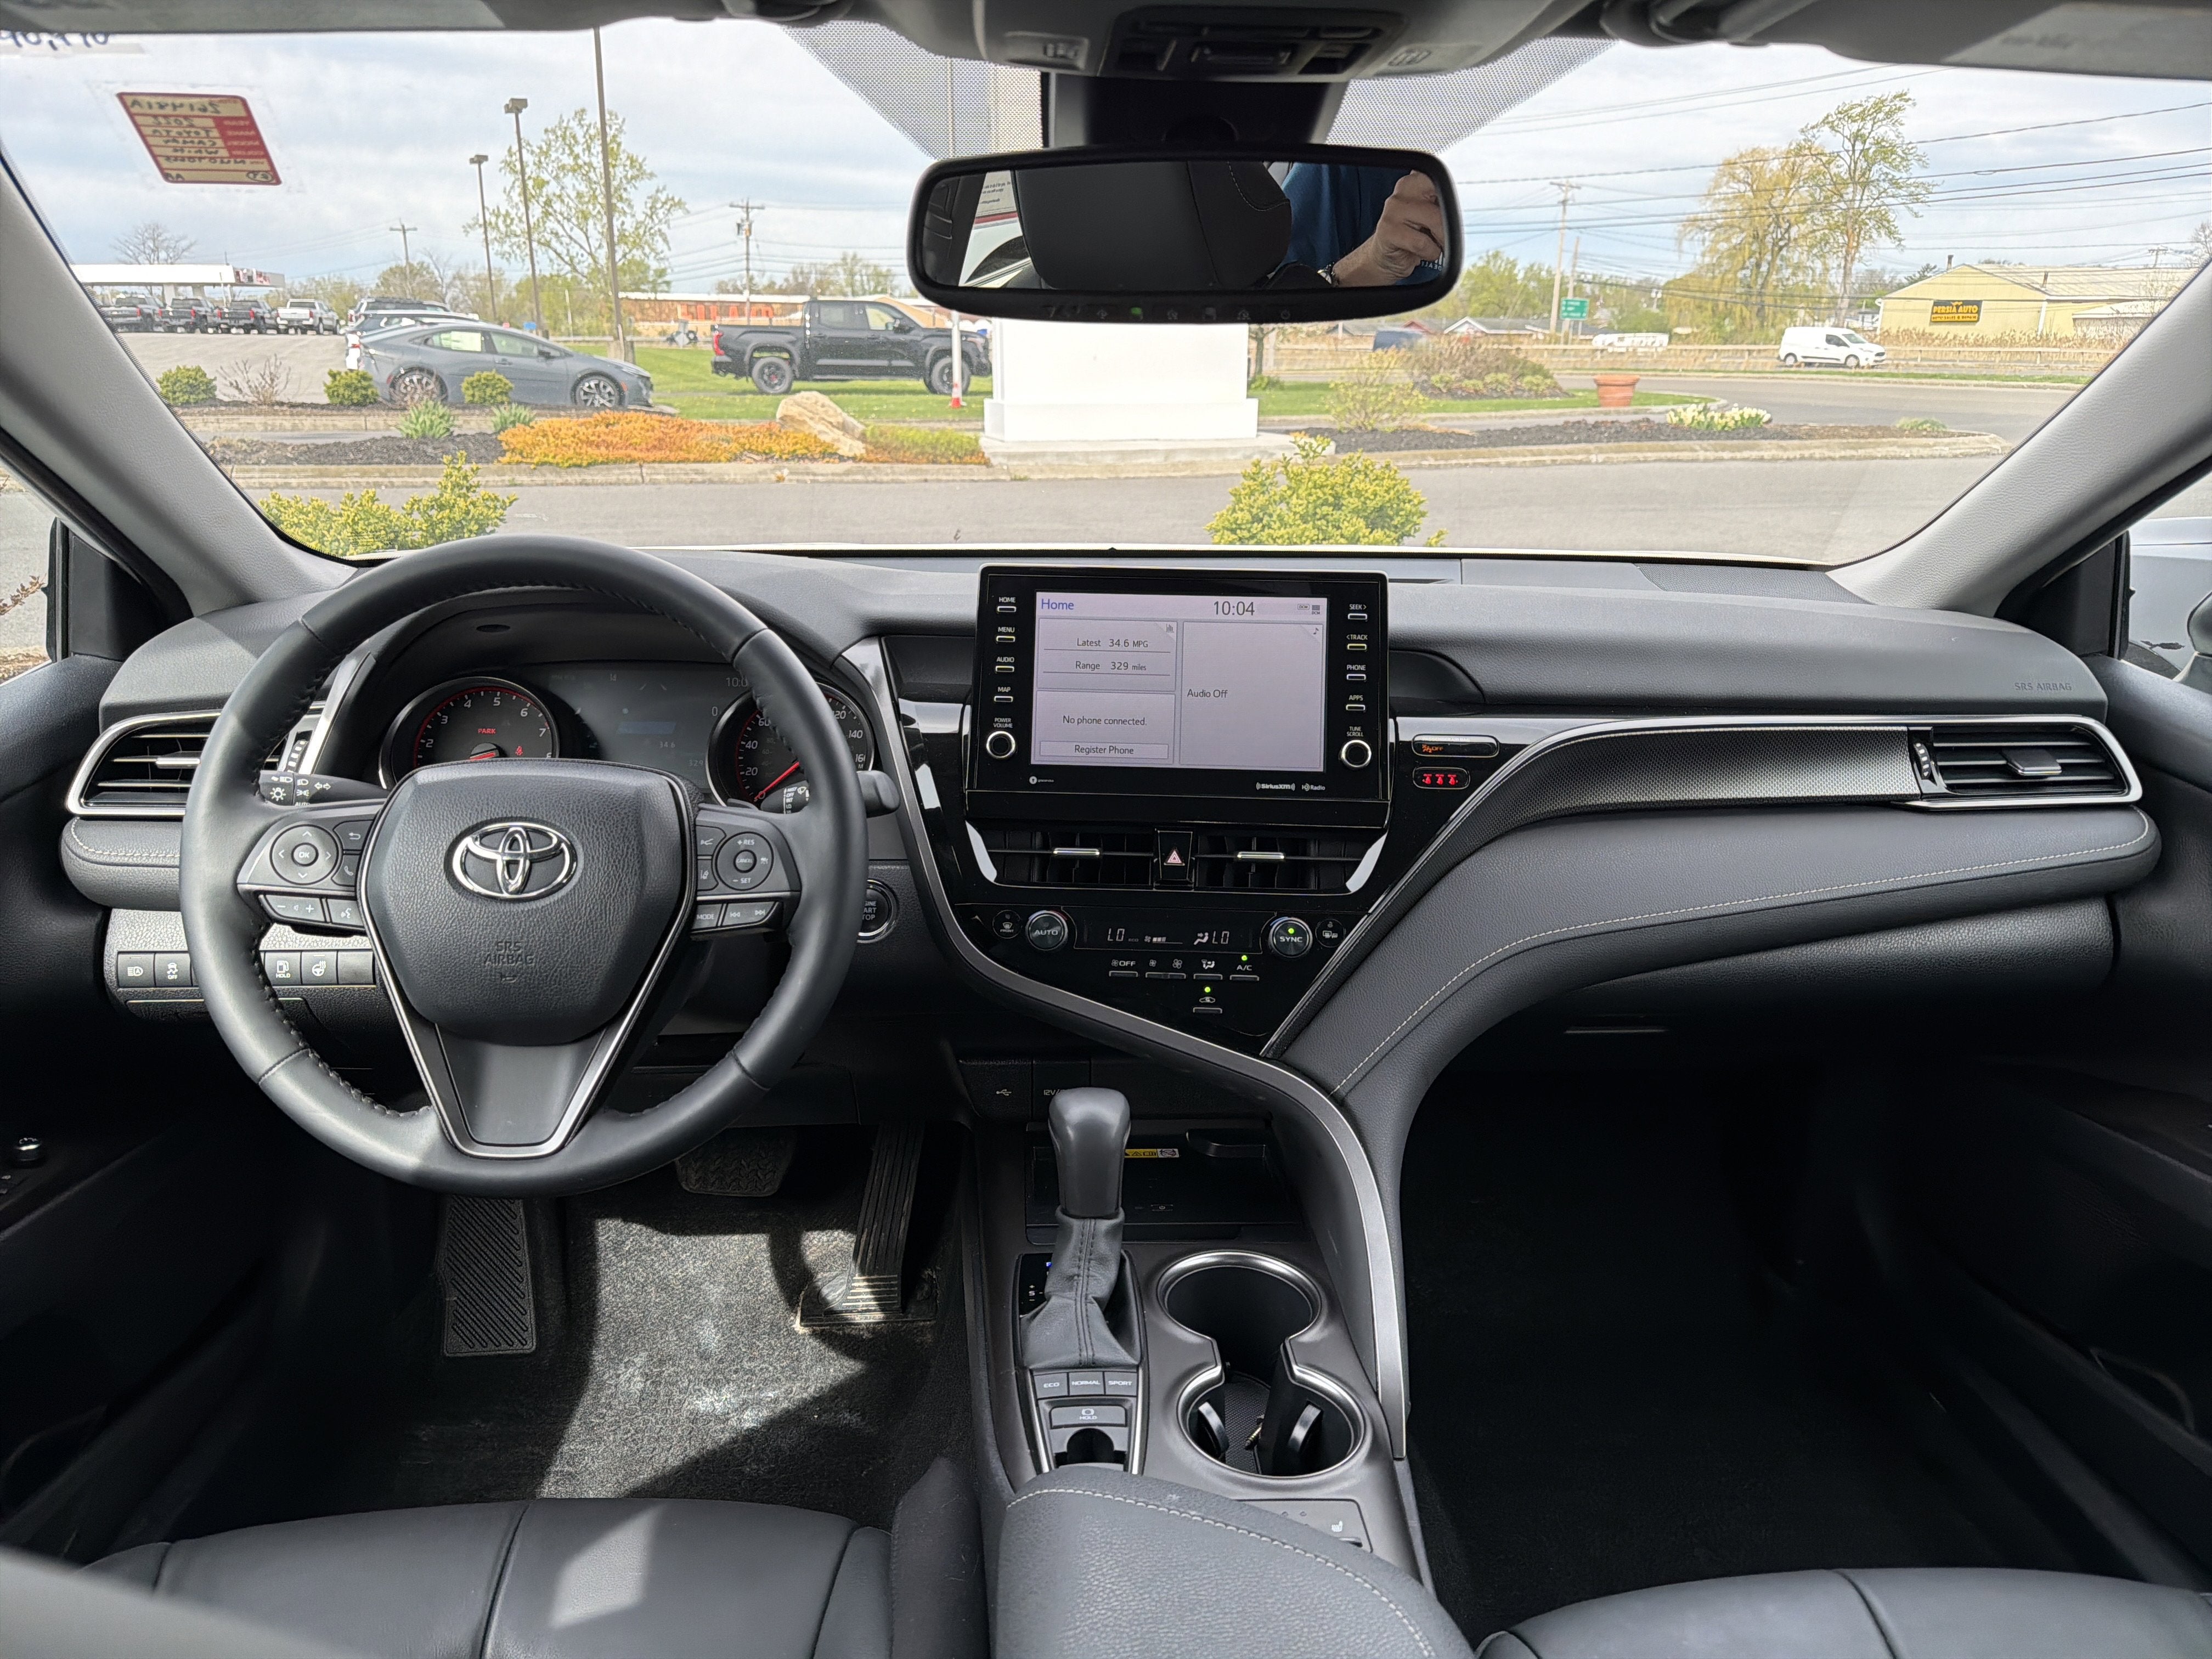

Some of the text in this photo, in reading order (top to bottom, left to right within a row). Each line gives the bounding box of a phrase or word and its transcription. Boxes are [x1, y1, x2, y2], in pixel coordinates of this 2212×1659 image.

[1041, 599, 1074, 610] Home
[1214, 601, 1255, 616] 10:04
[1077, 638, 1101, 647] Latest
[1109, 639, 1130, 647] 34.6
[1075, 661, 1101, 671] Range
[1110, 662, 1128, 670] 329
[726, 677, 747, 687] 10:0
[2015, 682, 2073, 691] SRS AIRBAG
[1187, 689, 1228, 698] Audio Off
[464, 698, 471, 708] 4
[493, 697, 501, 706] 5
[520, 708, 528, 717] 6
[441, 715, 448, 725] 3
[1063, 715, 1147, 726] No phone connected.
[539, 728, 547, 737] 7
[848, 730, 863, 739] 140
[425, 738, 433, 748] 2
[746, 740, 758, 749] 40
[1074, 744, 1134, 755] Register Phone
[745, 767, 758, 776] 20
[495, 941, 522, 952] SRS
[483, 953, 536, 966] AIRBAG
